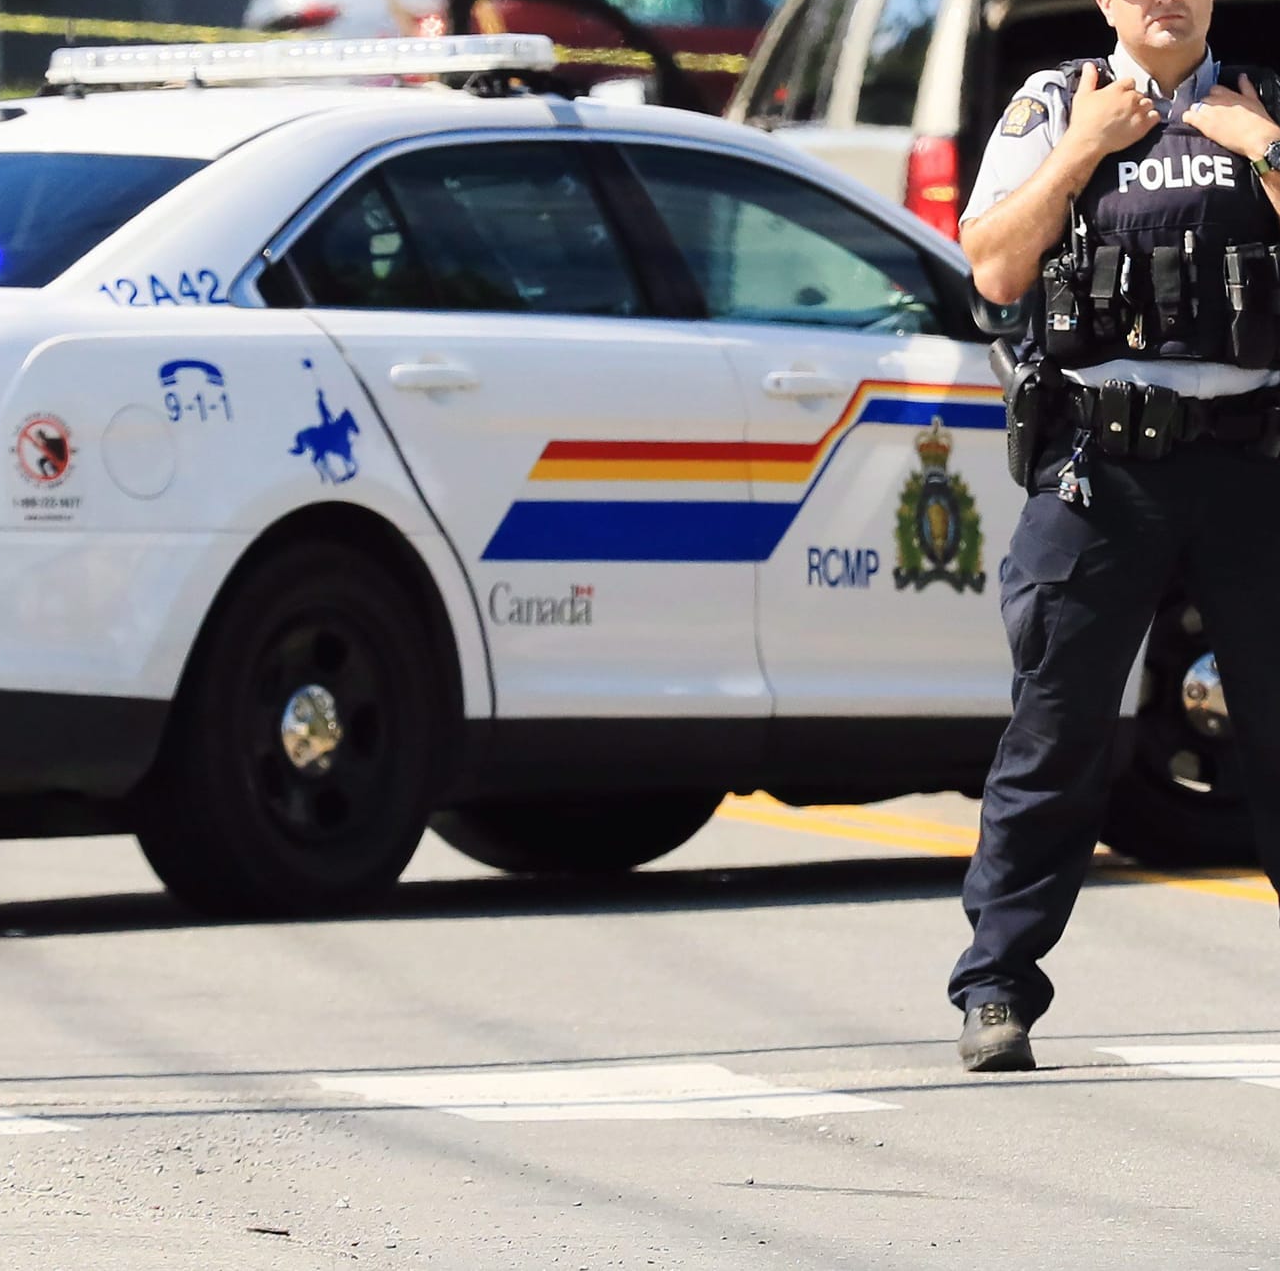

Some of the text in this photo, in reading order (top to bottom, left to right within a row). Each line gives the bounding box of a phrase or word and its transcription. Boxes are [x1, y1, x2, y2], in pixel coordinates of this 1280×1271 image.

[1117, 155, 1235, 194] POLICE
[99, 269, 230, 307] 12A42
[164, 392, 233, 422] 9-1-1
[807, 546, 880, 588] RCMP
[487, 581, 593, 627] Canada
